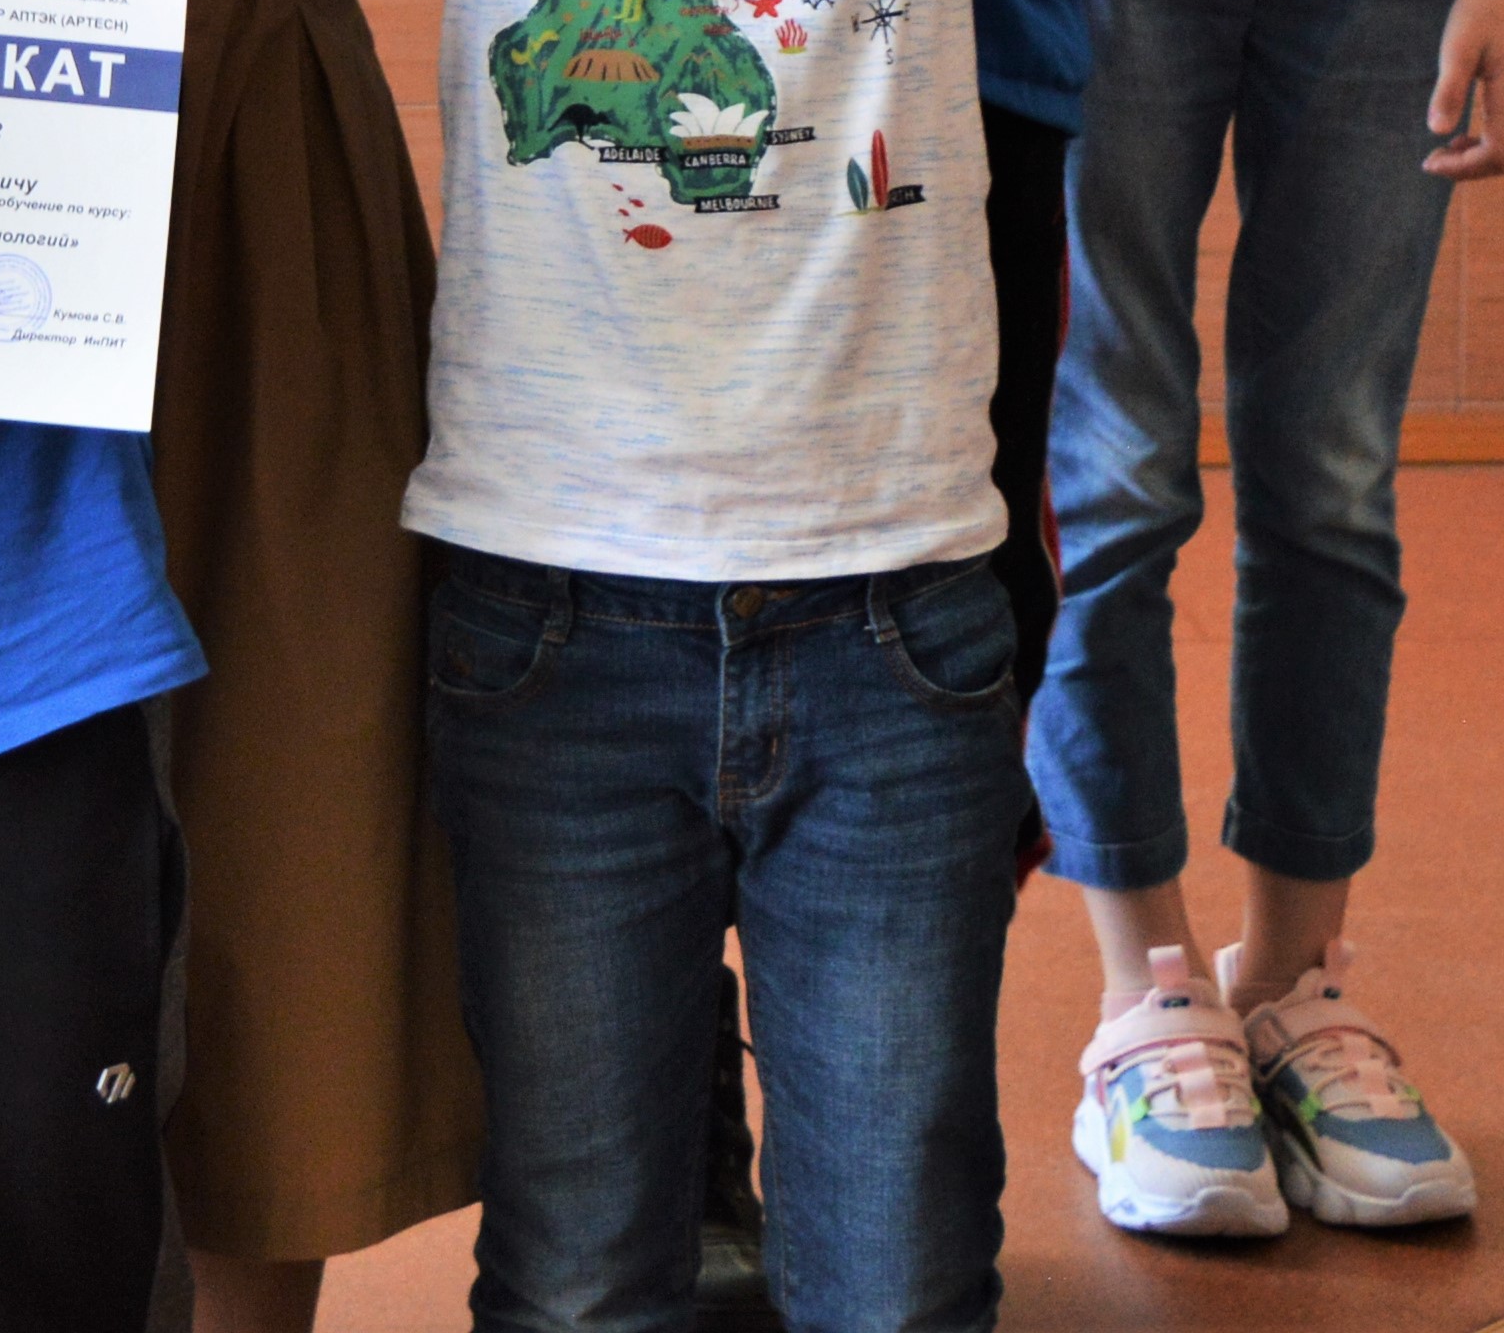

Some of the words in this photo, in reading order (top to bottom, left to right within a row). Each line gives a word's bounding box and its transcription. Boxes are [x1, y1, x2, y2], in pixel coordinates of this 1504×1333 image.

[603, 147, 661, 162] ADELAIDE
[684, 153, 747, 169] CANBERRA
[700, 196, 776, 212] MELBOURNE
